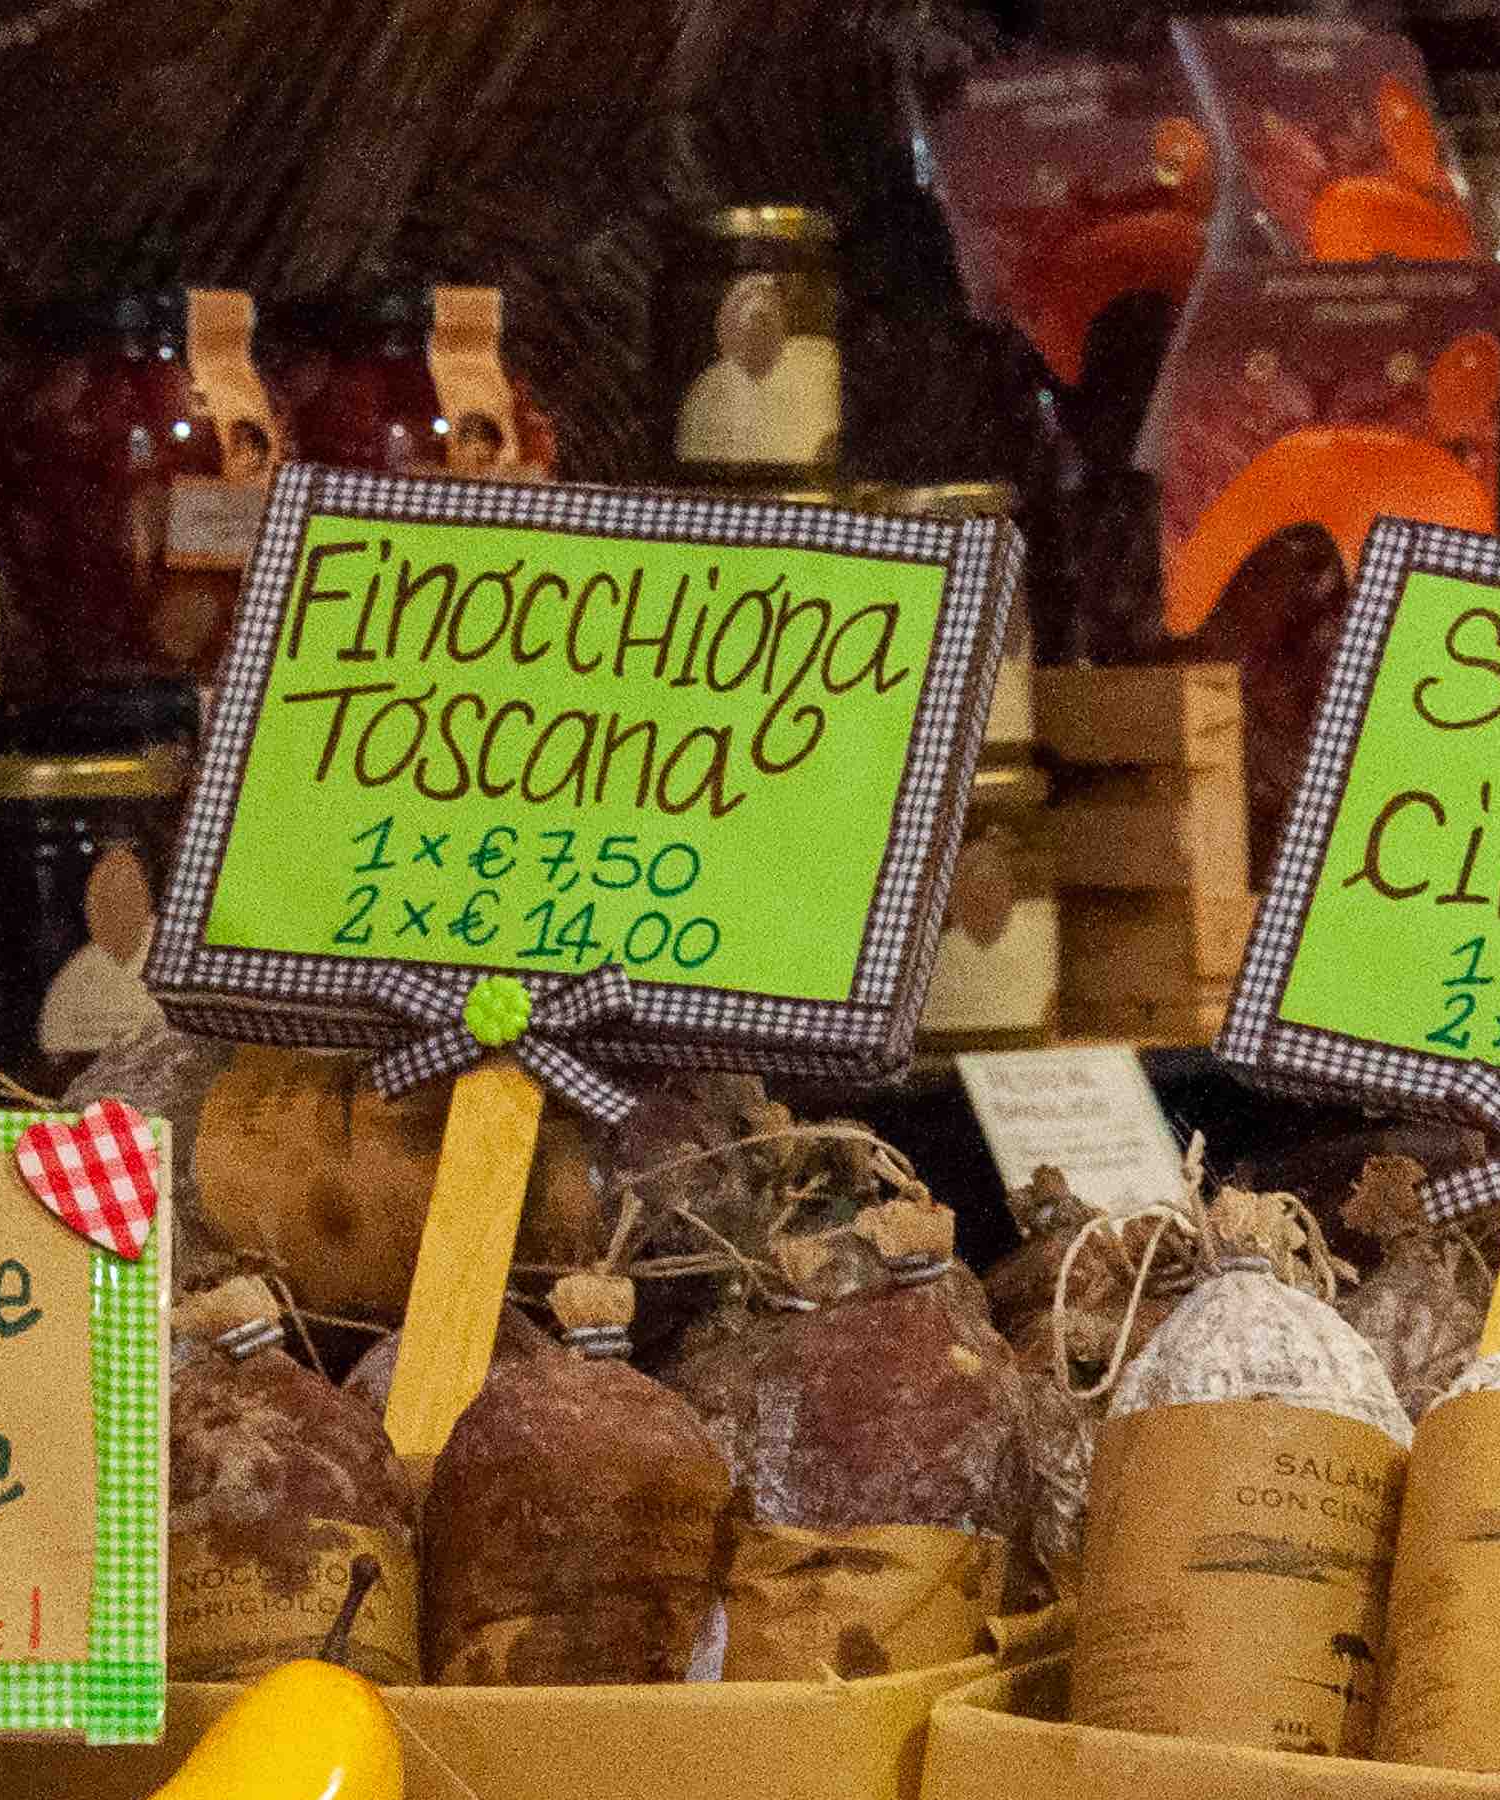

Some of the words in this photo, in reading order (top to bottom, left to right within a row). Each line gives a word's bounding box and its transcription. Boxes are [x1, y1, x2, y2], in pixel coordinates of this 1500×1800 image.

[354, 817, 395, 874] 1
[469, 827, 518, 879] €
[539, 832, 700, 897] 7,50
[334, 885, 377, 946] 2
[450, 889, 500, 948] €
[516, 899, 721, 967] 14,00
[1444, 937, 1491, 988] 1
[1427, 994, 1473, 1051] 2
